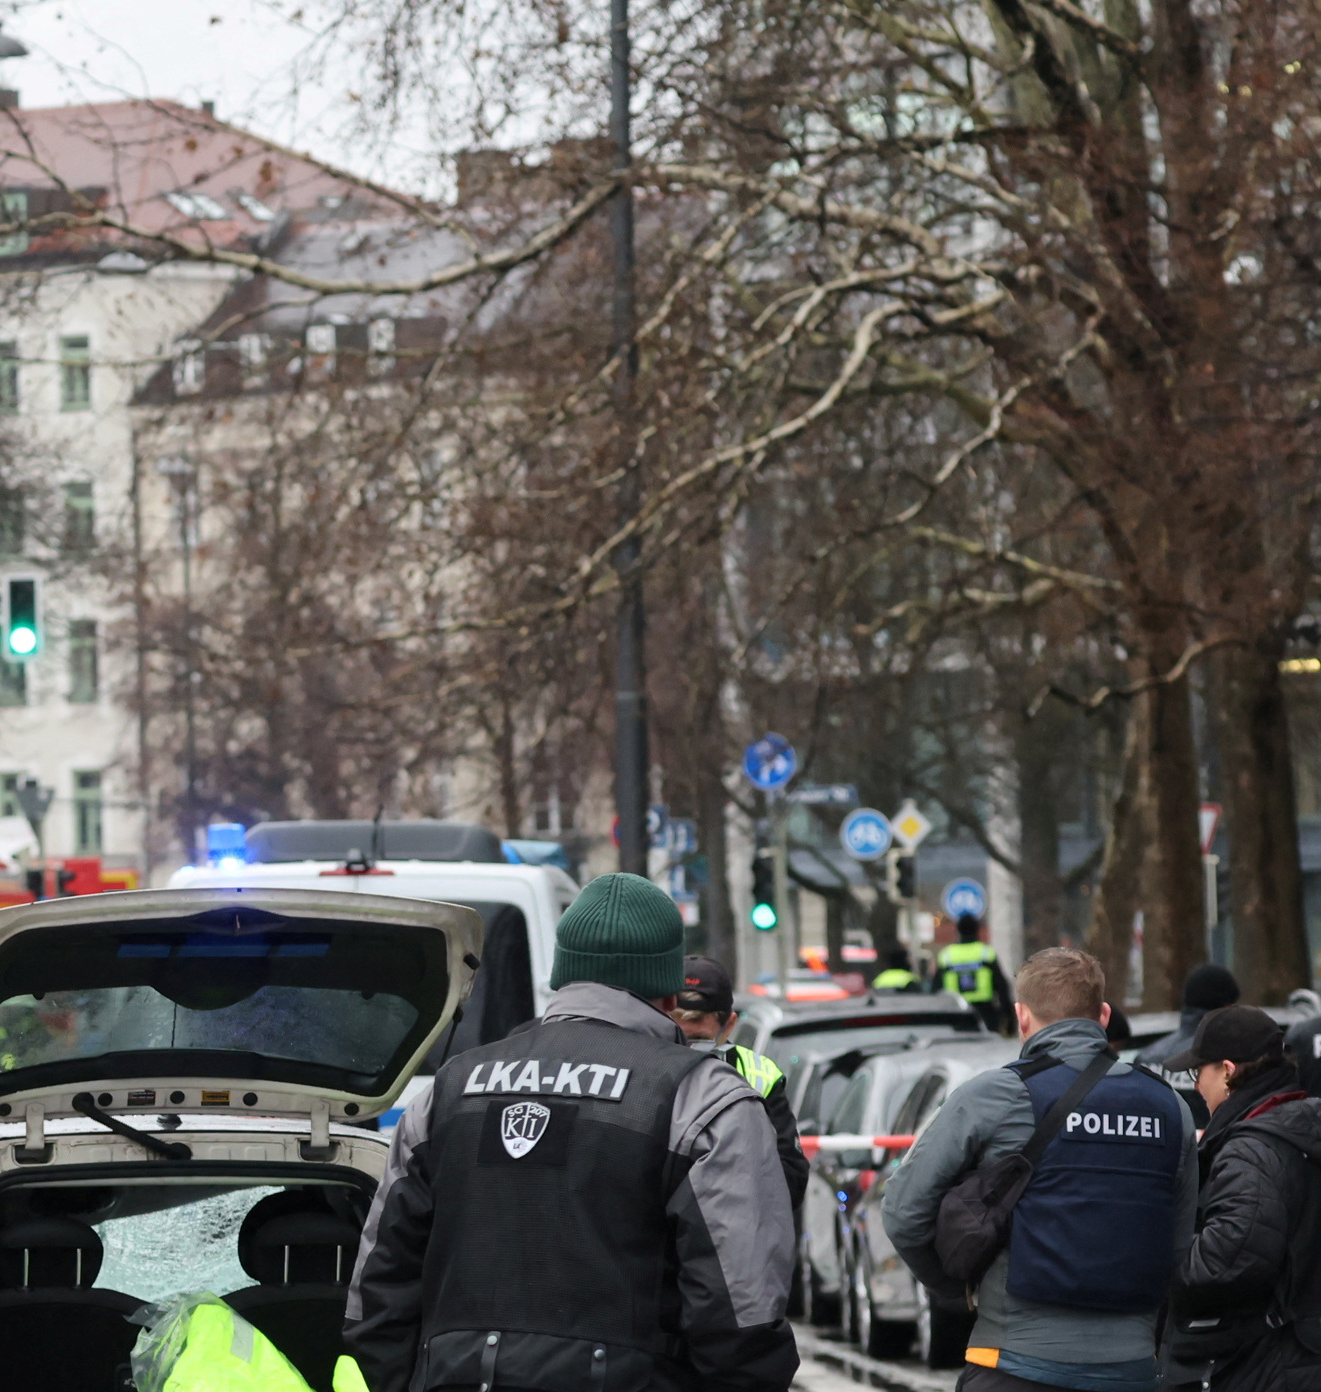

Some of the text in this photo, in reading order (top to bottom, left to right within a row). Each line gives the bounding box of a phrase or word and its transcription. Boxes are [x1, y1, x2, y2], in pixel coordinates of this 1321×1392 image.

[463, 1060, 630, 1099] LKA-KTI
[507, 1105, 548, 1118] SG 207
[1066, 1111, 1161, 1139] POLIZEI
